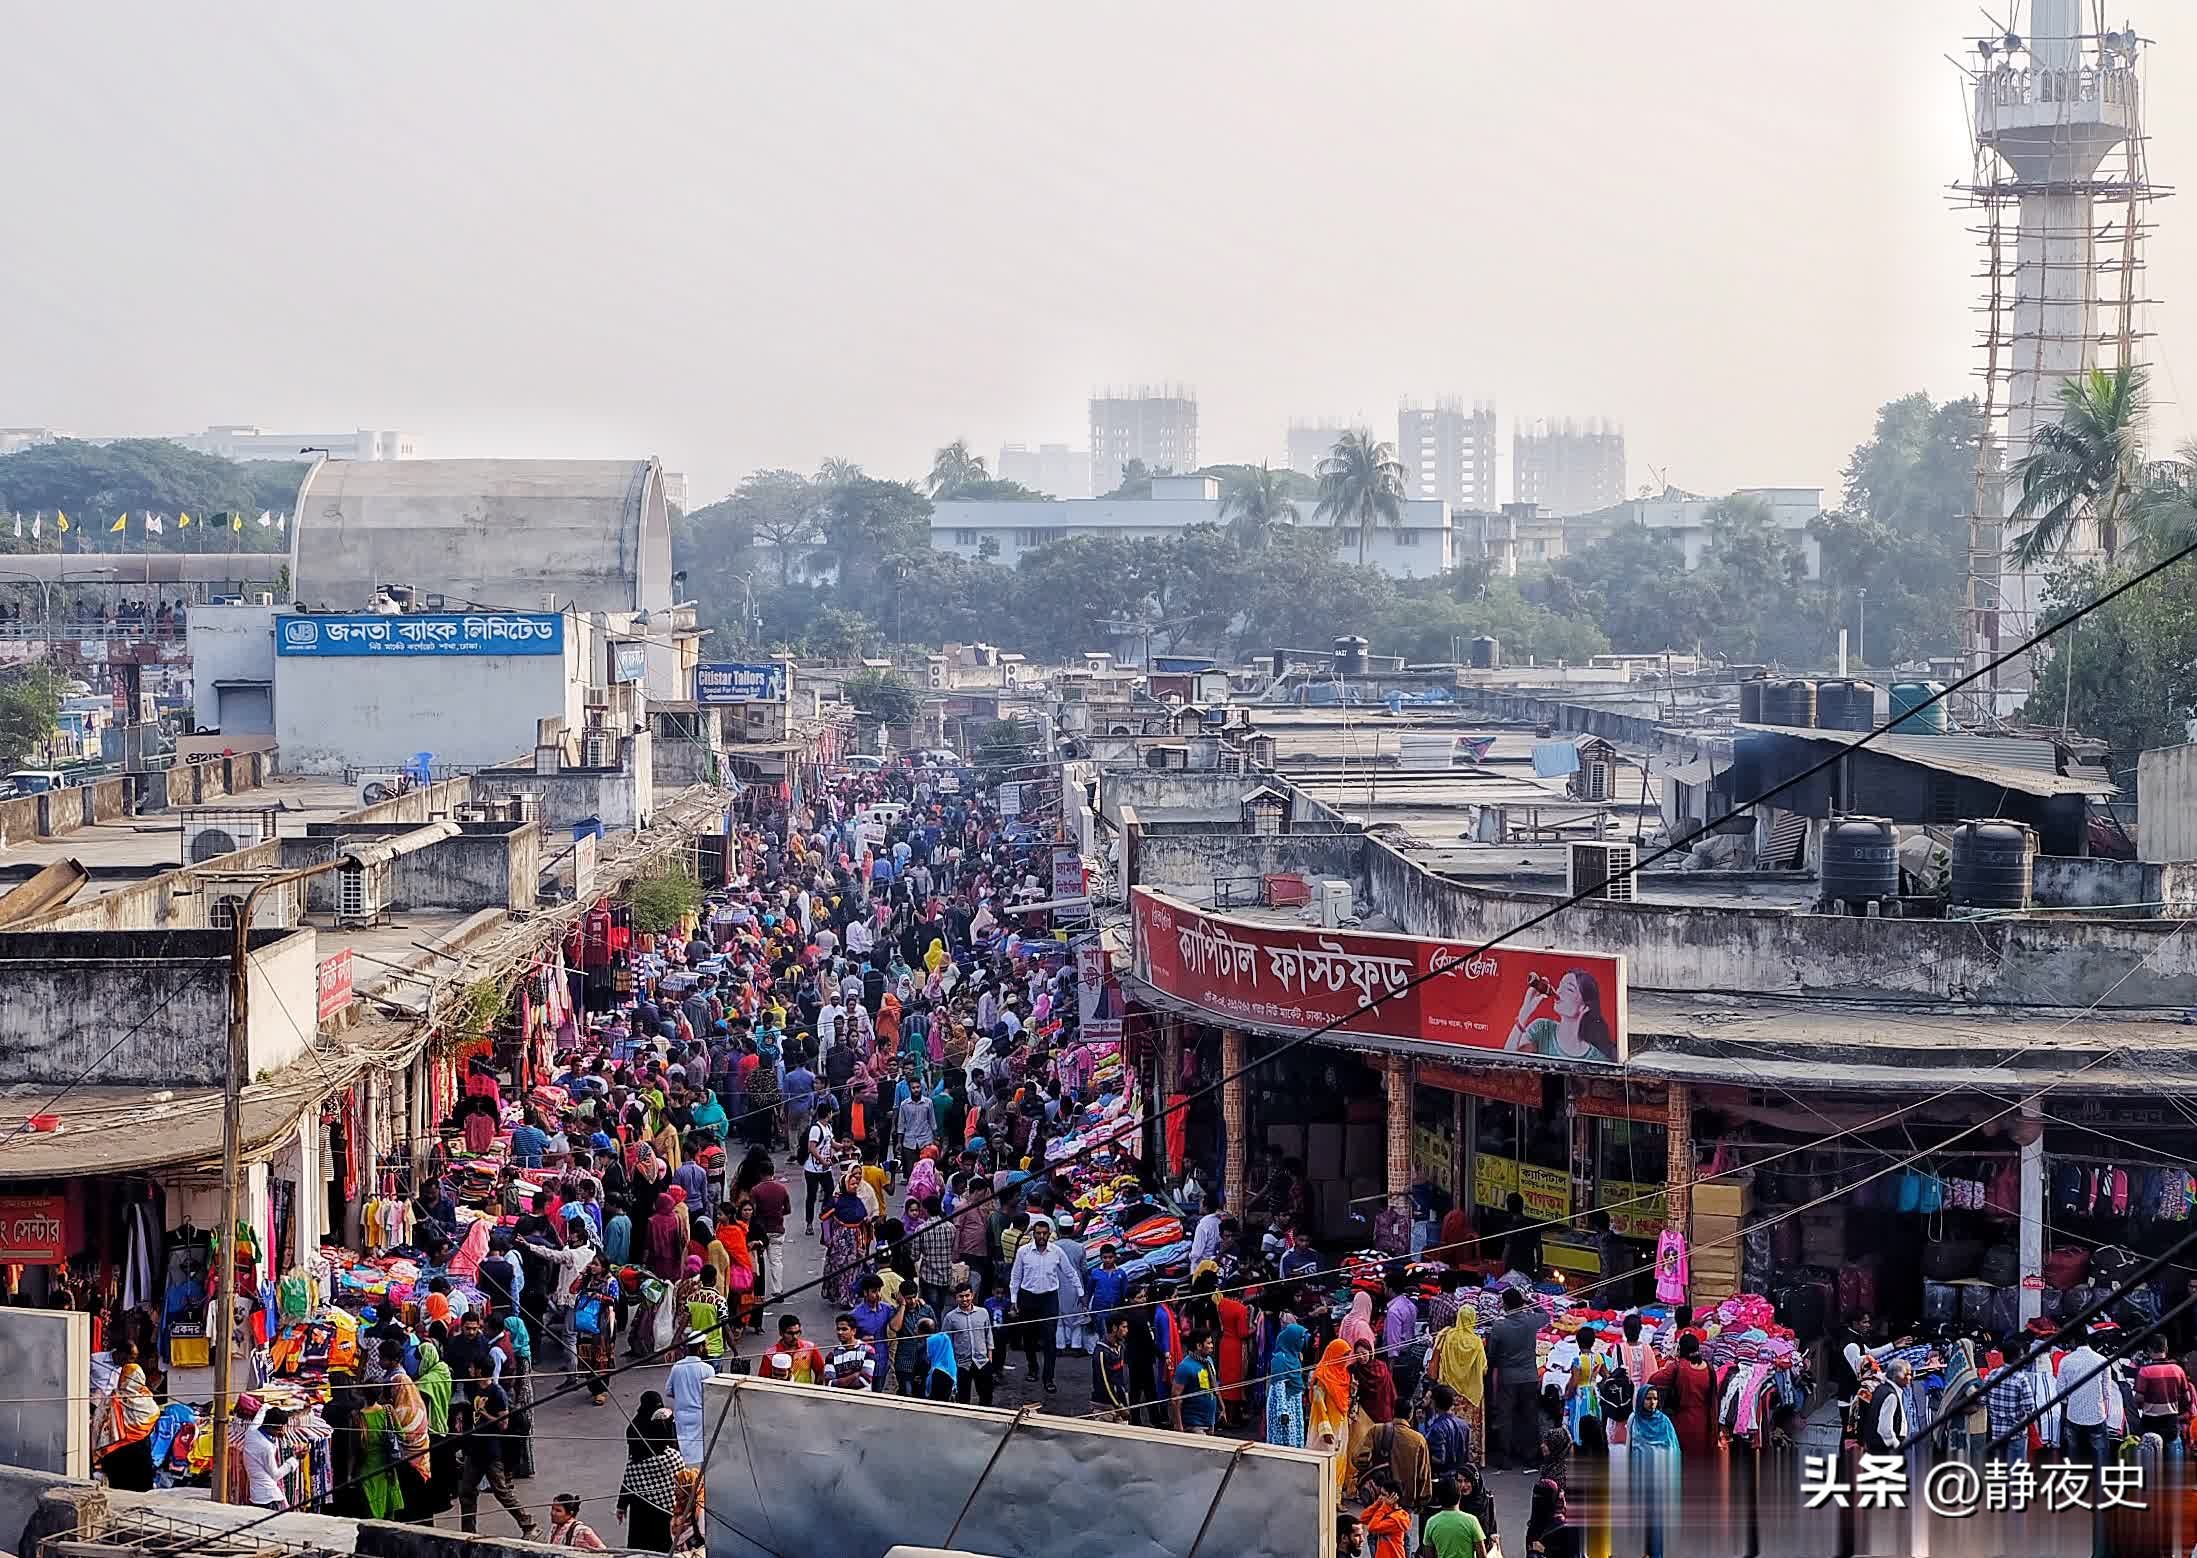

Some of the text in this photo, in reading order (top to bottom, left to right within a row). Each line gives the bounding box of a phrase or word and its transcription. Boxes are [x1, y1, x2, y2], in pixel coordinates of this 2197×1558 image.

[325, 617, 553, 641] জনতা ব্যাংক লিমিটেড
[699, 670, 765, 686] Citistar Tailors
[1176, 917, 1257, 988] ক্যাপিটাল
[1521, 1168, 1566, 1184] ক্যাপিটাল
[14, 1211, 60, 1243] সেন্টার
